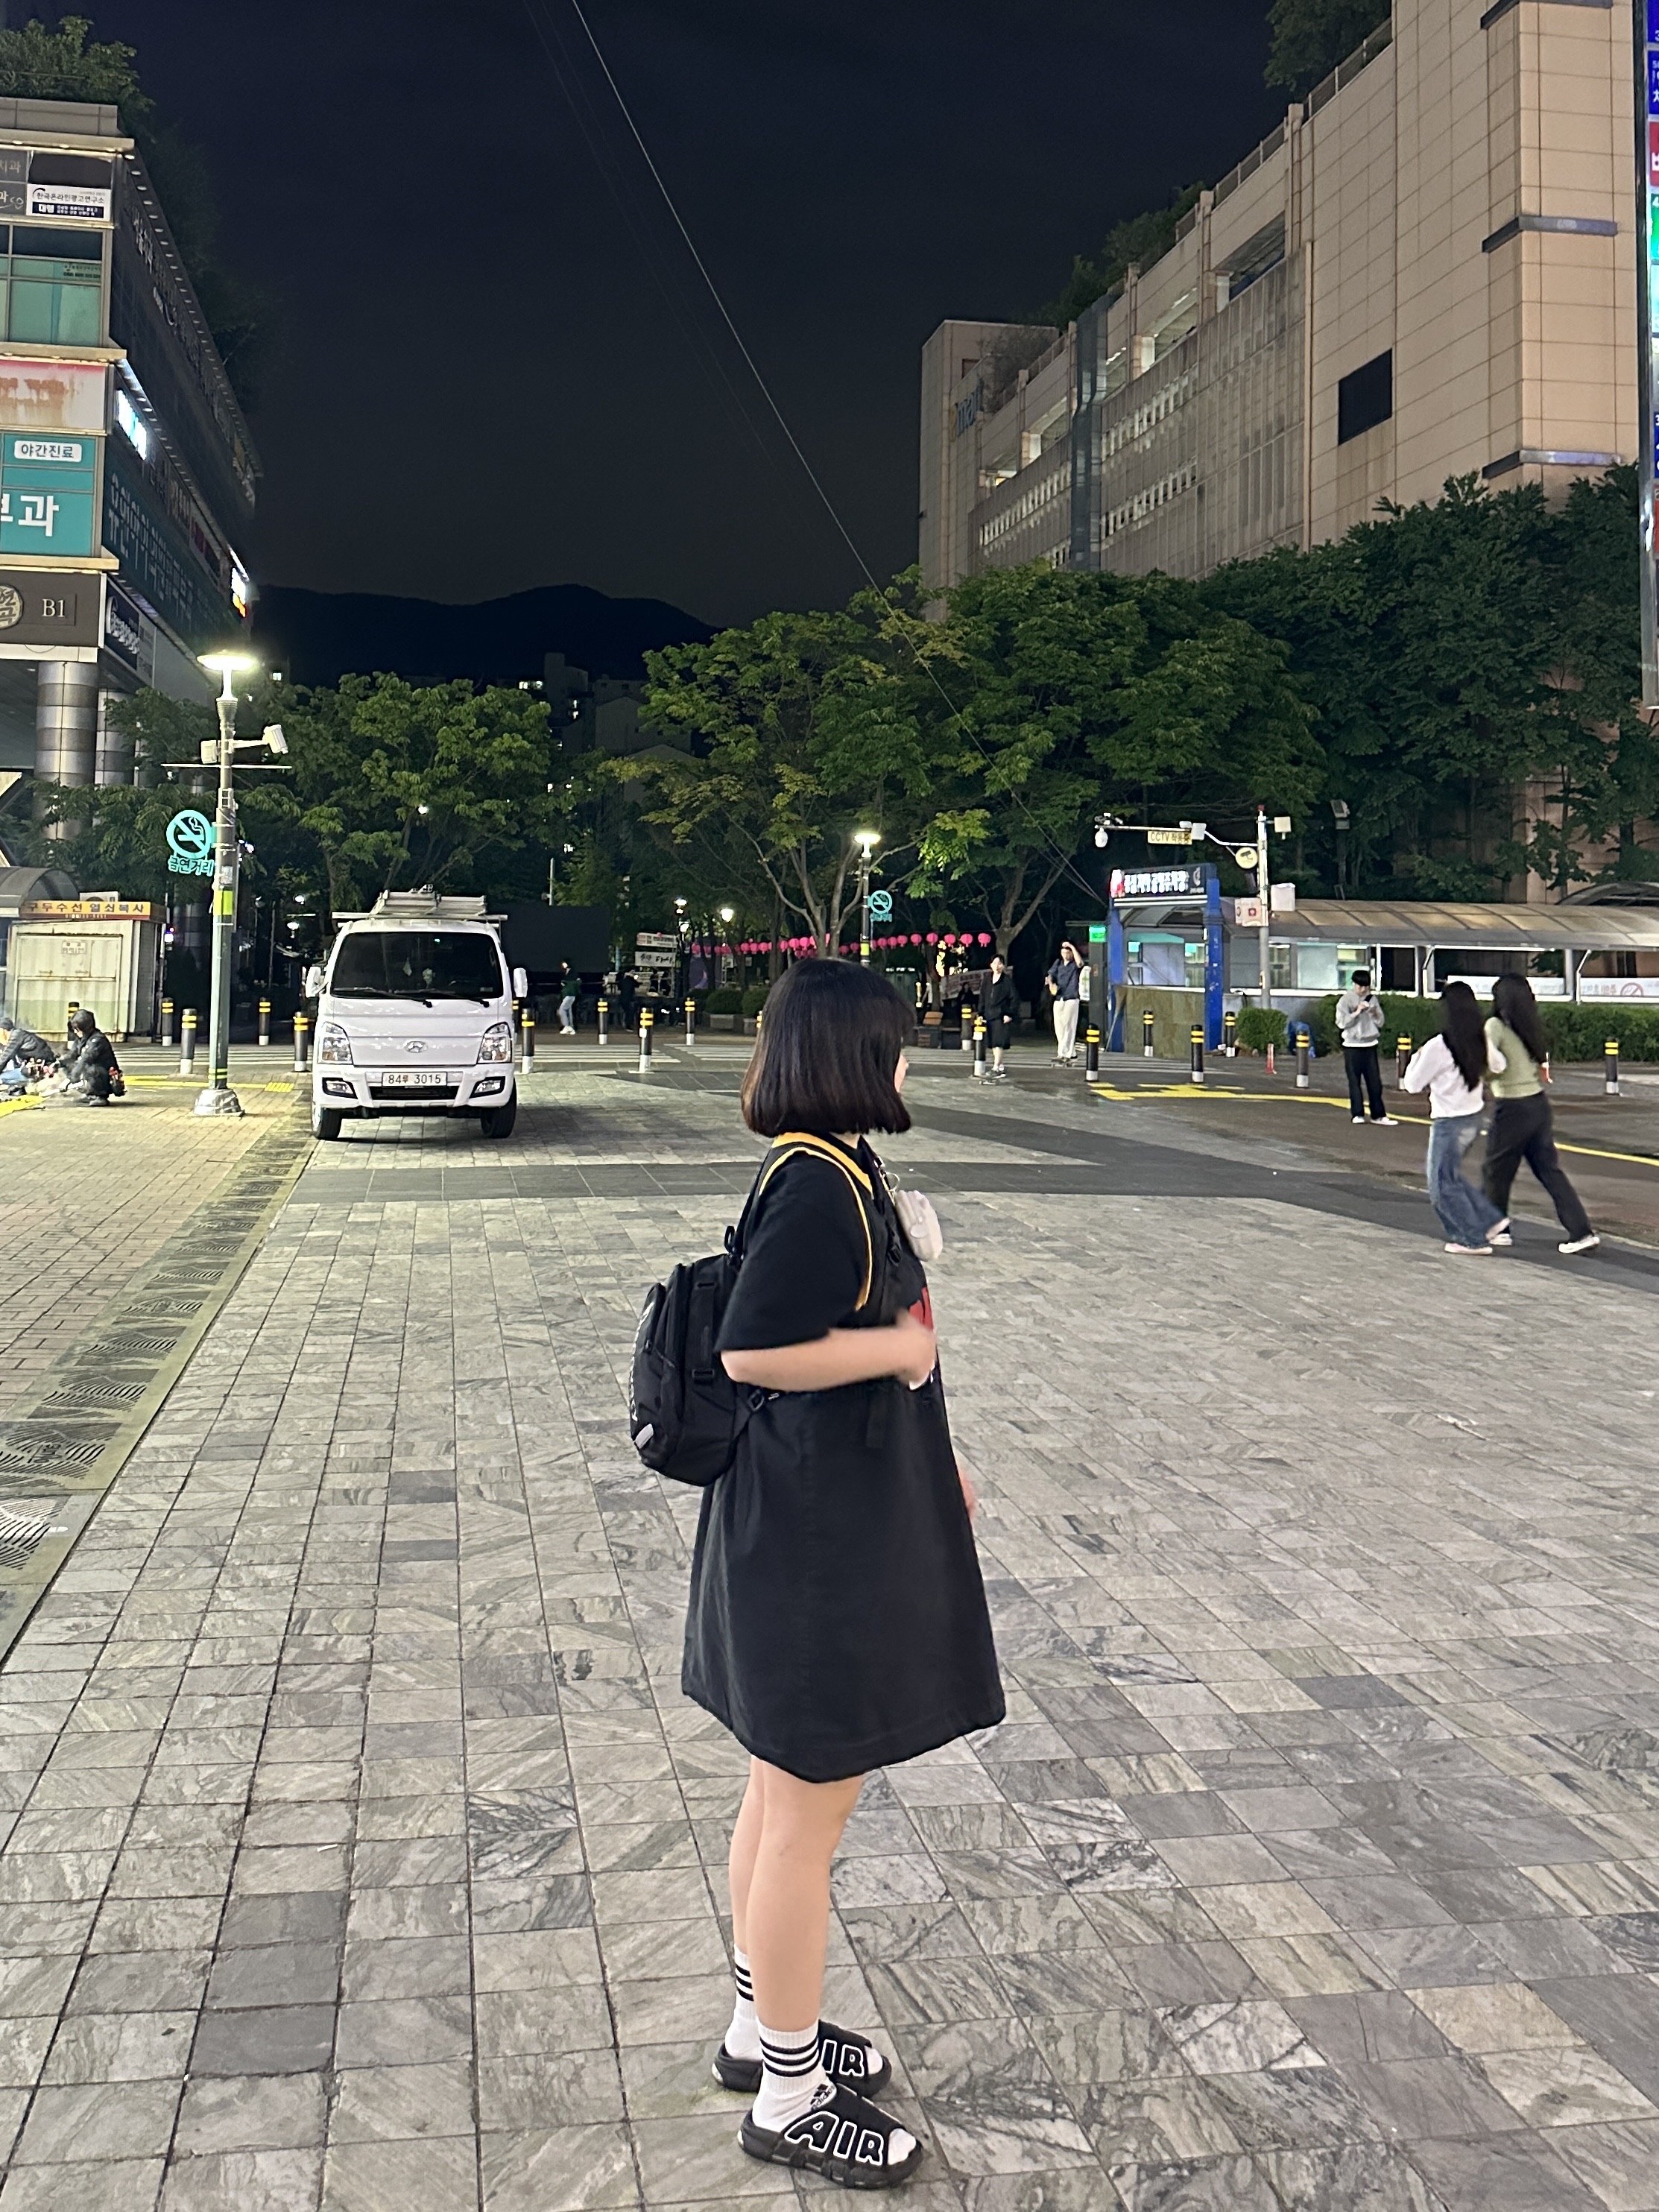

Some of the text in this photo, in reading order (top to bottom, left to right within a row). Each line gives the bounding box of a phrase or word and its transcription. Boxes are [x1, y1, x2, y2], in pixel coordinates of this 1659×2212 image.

[21, 443, 75, 459] 야간진료
[41, 598, 65, 618] B1
[1150, 832, 1170, 842] CCTV
[168, 856, 215, 875] 금연거리
[27, 902, 83, 913] 구두수선
[414, 1074, 441, 1084] 3015
[820, 2039, 865, 2077] IR
[784, 2111, 885, 2166] AIR
